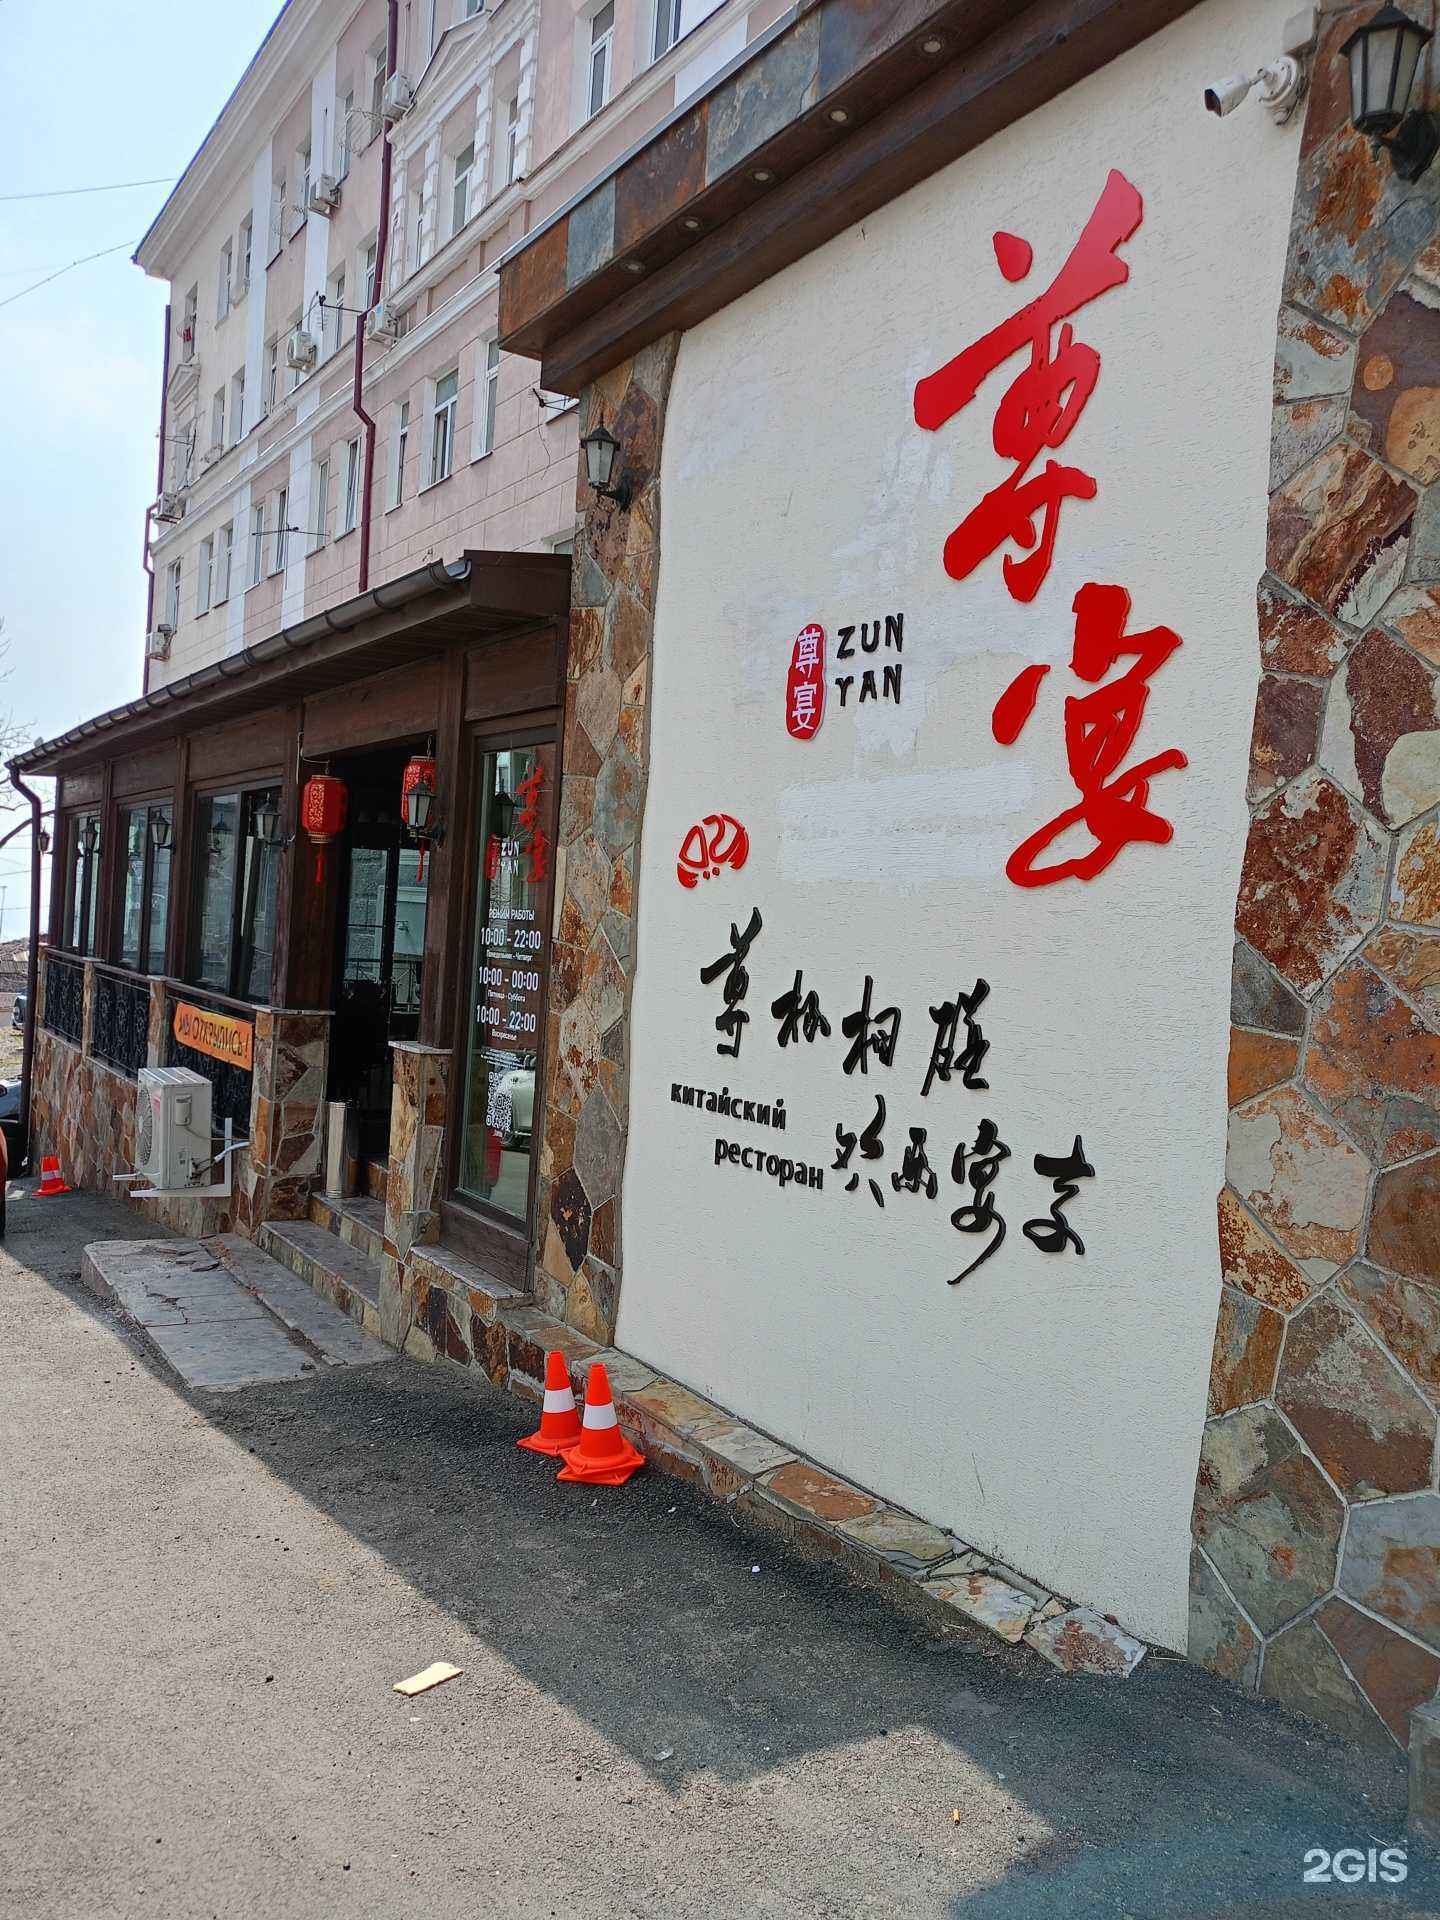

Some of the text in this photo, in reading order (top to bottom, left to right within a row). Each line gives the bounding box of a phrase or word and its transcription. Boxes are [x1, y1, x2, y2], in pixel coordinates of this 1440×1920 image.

[914, 168, 1188, 887] 尊宴
[837, 613, 904, 659] ZUN
[835, 664, 903, 707] YAN
[501, 841, 520, 856] ZUN
[488, 908, 535, 920] РЕЖИМ РАБОТЫ
[481, 927, 505, 946] 10:00
[513, 929, 541, 950] 22:00
[479, 966, 502, 986] 10:00
[511, 970, 538, 991] 00:00
[476, 1004, 500, 1026] 10:00
[509, 1010, 536, 1033] 22:00
[670, 1083, 787, 1130] китайский
[714, 1138, 824, 1190] ресторан
